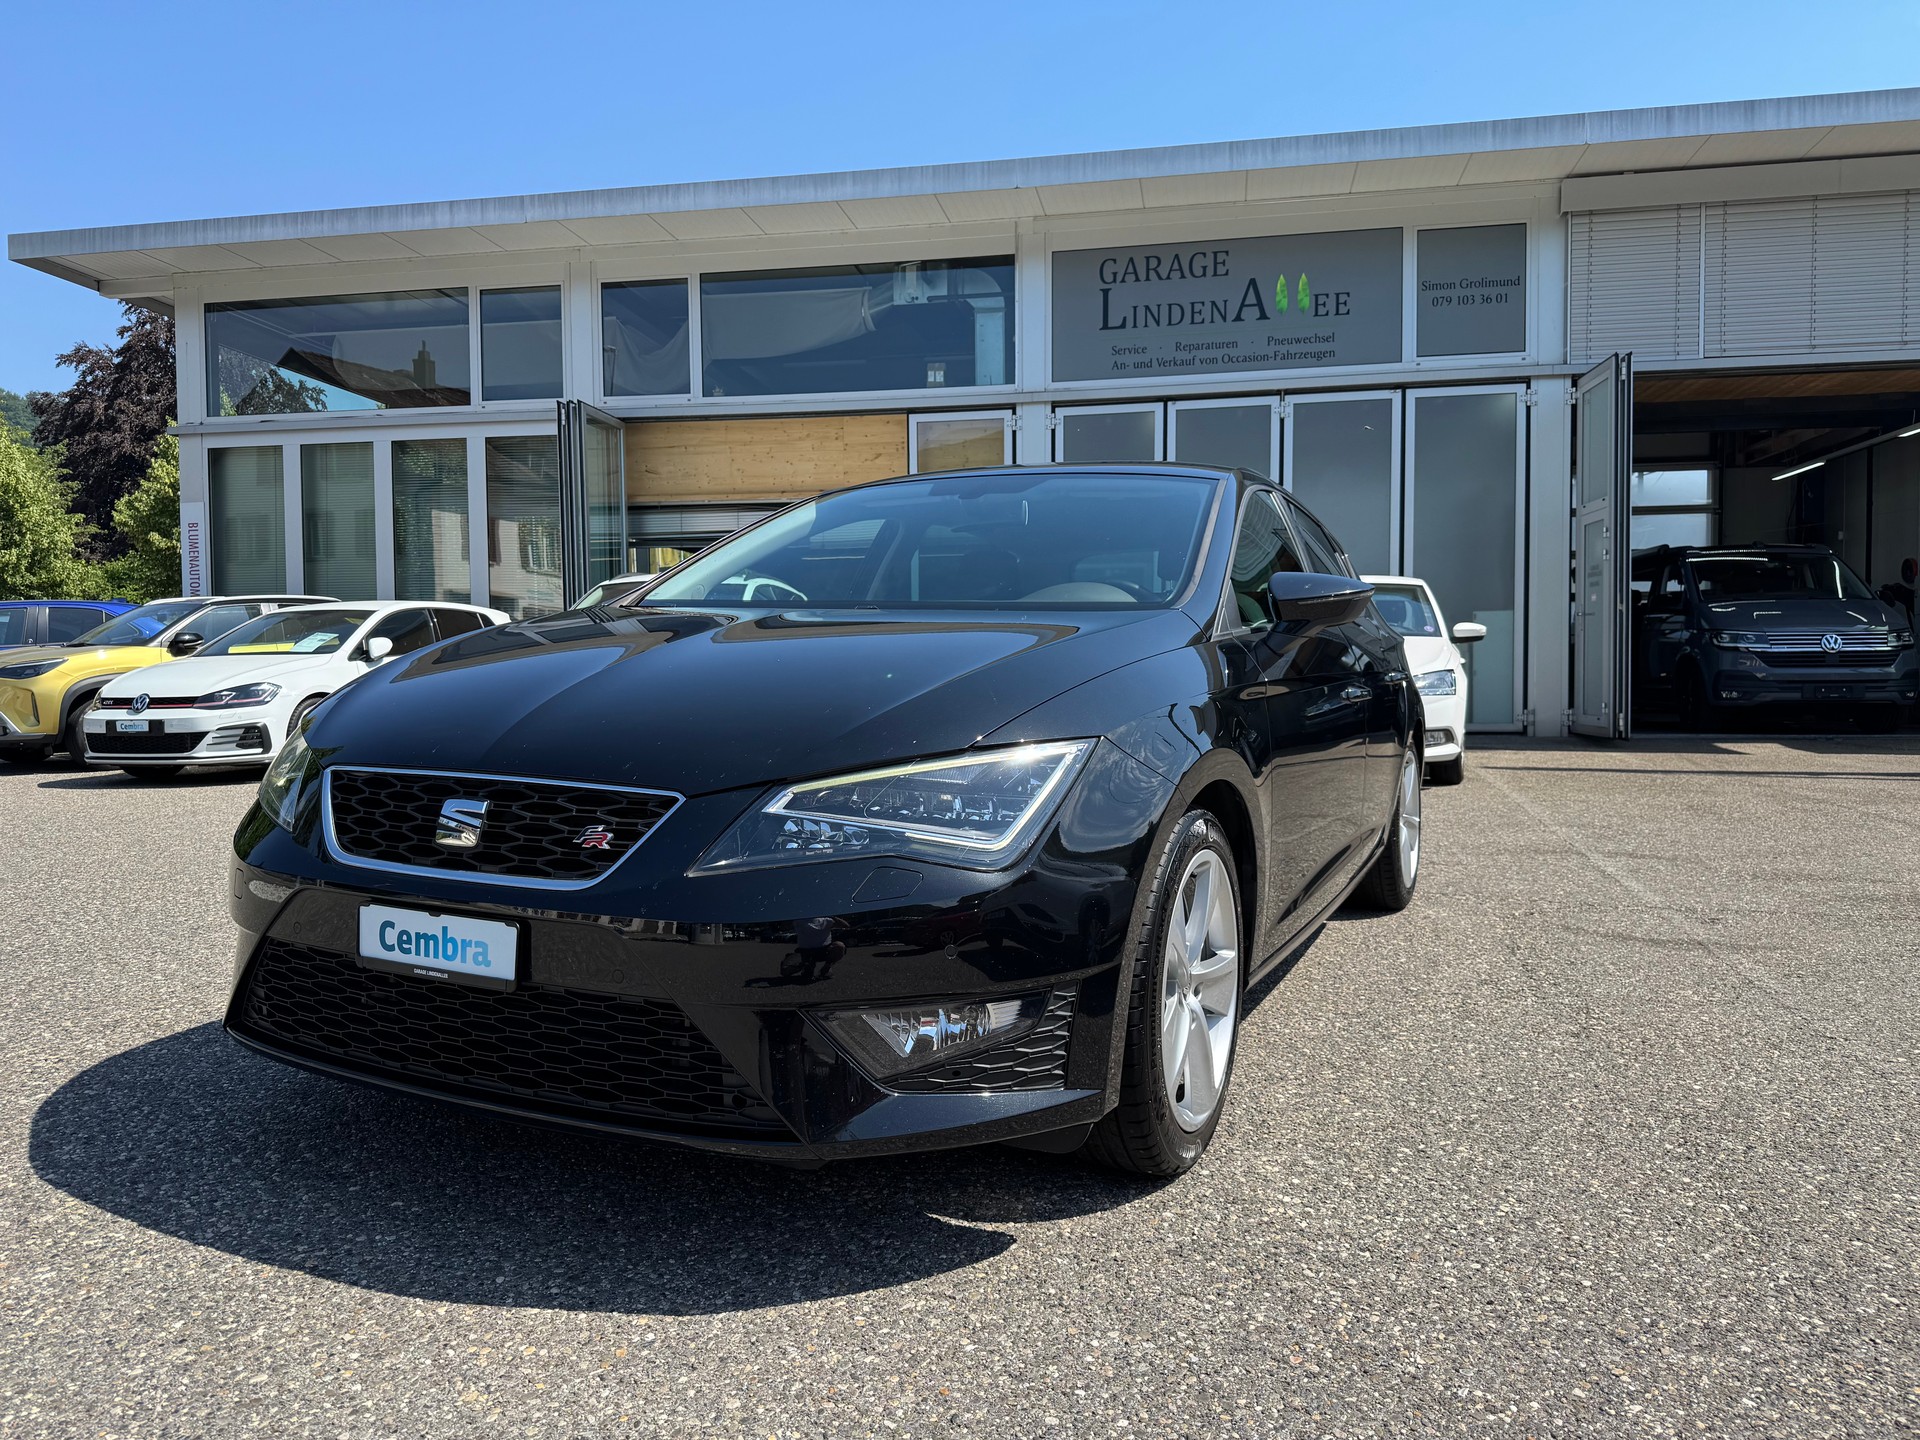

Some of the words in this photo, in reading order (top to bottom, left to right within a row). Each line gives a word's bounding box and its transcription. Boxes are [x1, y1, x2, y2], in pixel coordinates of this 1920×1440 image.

[1099, 250, 1230, 285] GARAGE
[1421, 280, 1456, 291] Simon
[1459, 276, 1520, 289] Grolimund
[1431, 296, 1452, 307] 079
[1457, 294, 1475, 305] 103
[1479, 294, 1493, 304] 36
[1495, 293, 1508, 303] 01
[1111, 344, 1148, 356] Service
[1175, 341, 1238, 354] Reparaturen
[1267, 332, 1335, 346] Pneuwechsel
[1111, 360, 1130, 370] An-
[1133, 358, 1153, 369] und
[1156, 355, 1197, 368] Verkauf
[1199, 357, 1218, 365] von
[1221, 349, 1336, 365] Occasion-Fahrzeugen
[120, 722, 145, 730] Cembra
[379, 919, 492, 968] Cembra
